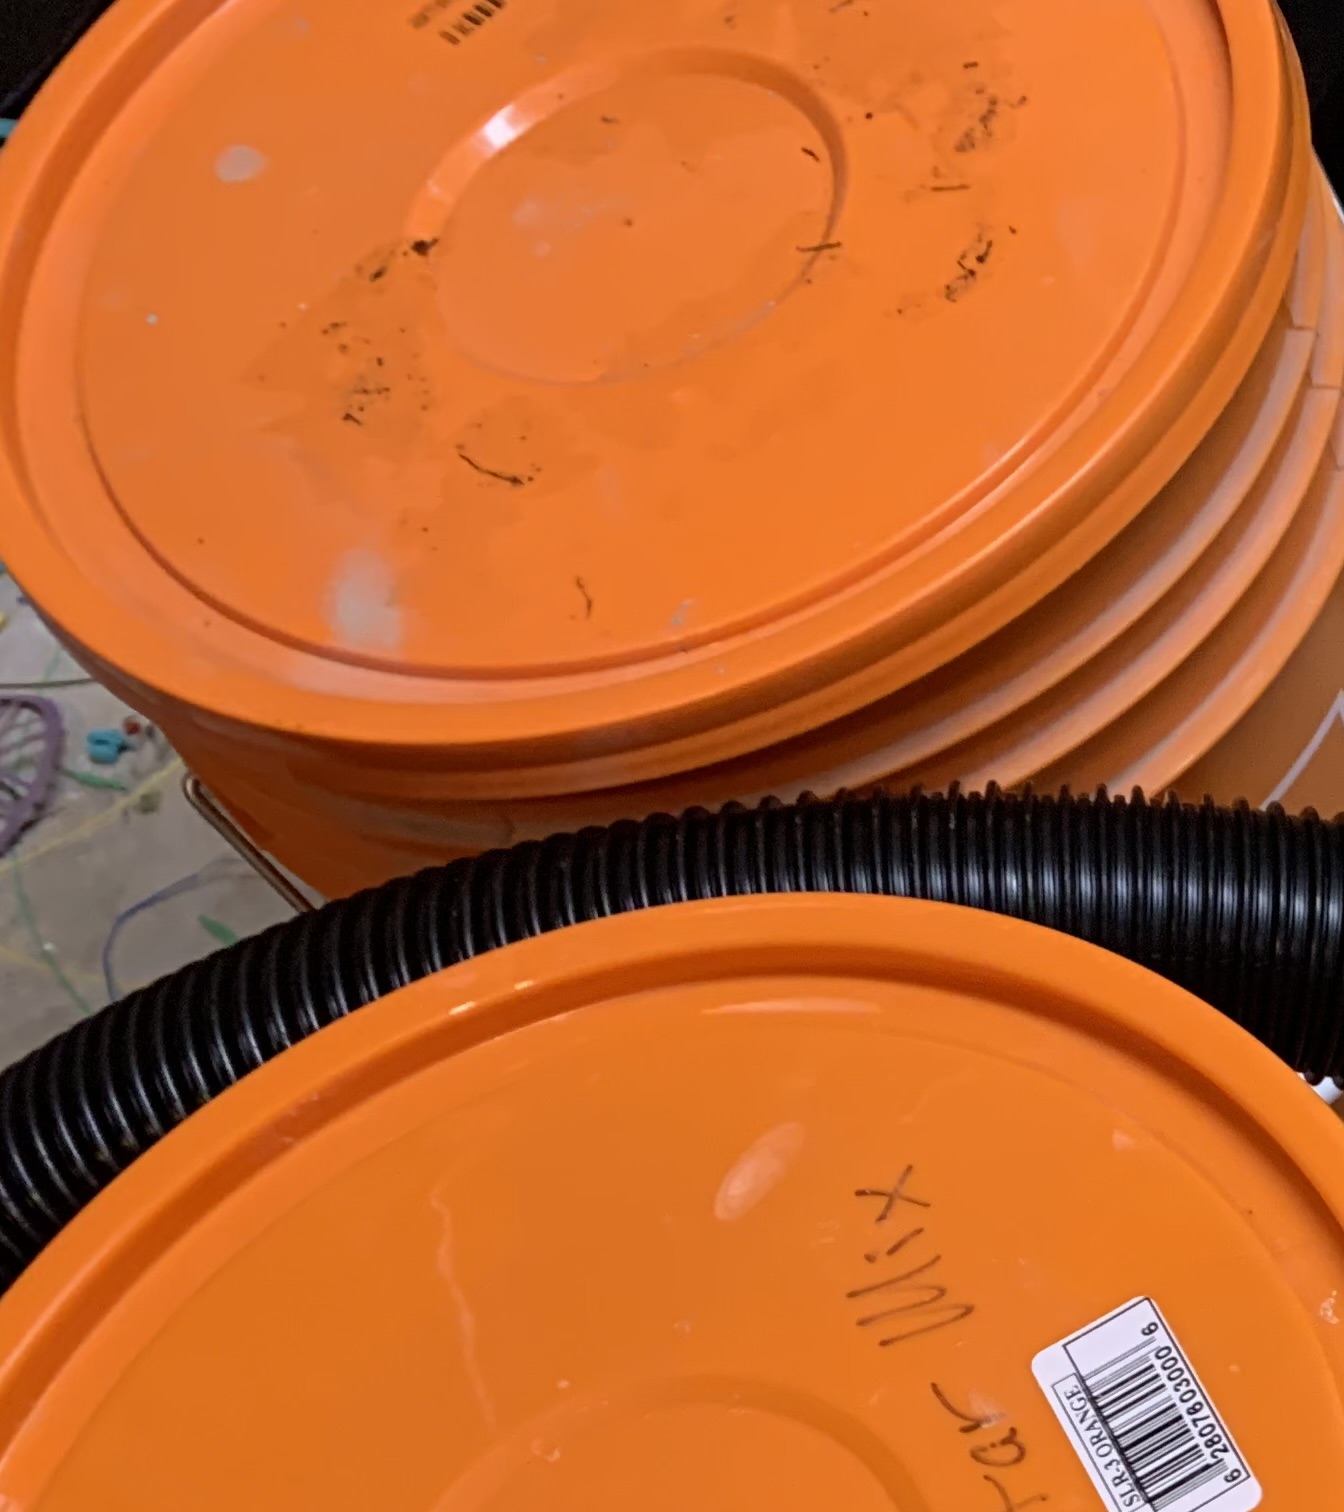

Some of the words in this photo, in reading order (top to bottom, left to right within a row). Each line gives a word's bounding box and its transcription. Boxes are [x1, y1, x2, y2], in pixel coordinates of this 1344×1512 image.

[847, 1164, 974, 1346] Mix
[1064, 1383, 1114, 1459] ORANGE
[1103, 1457, 1140, 1508] SLR-3
